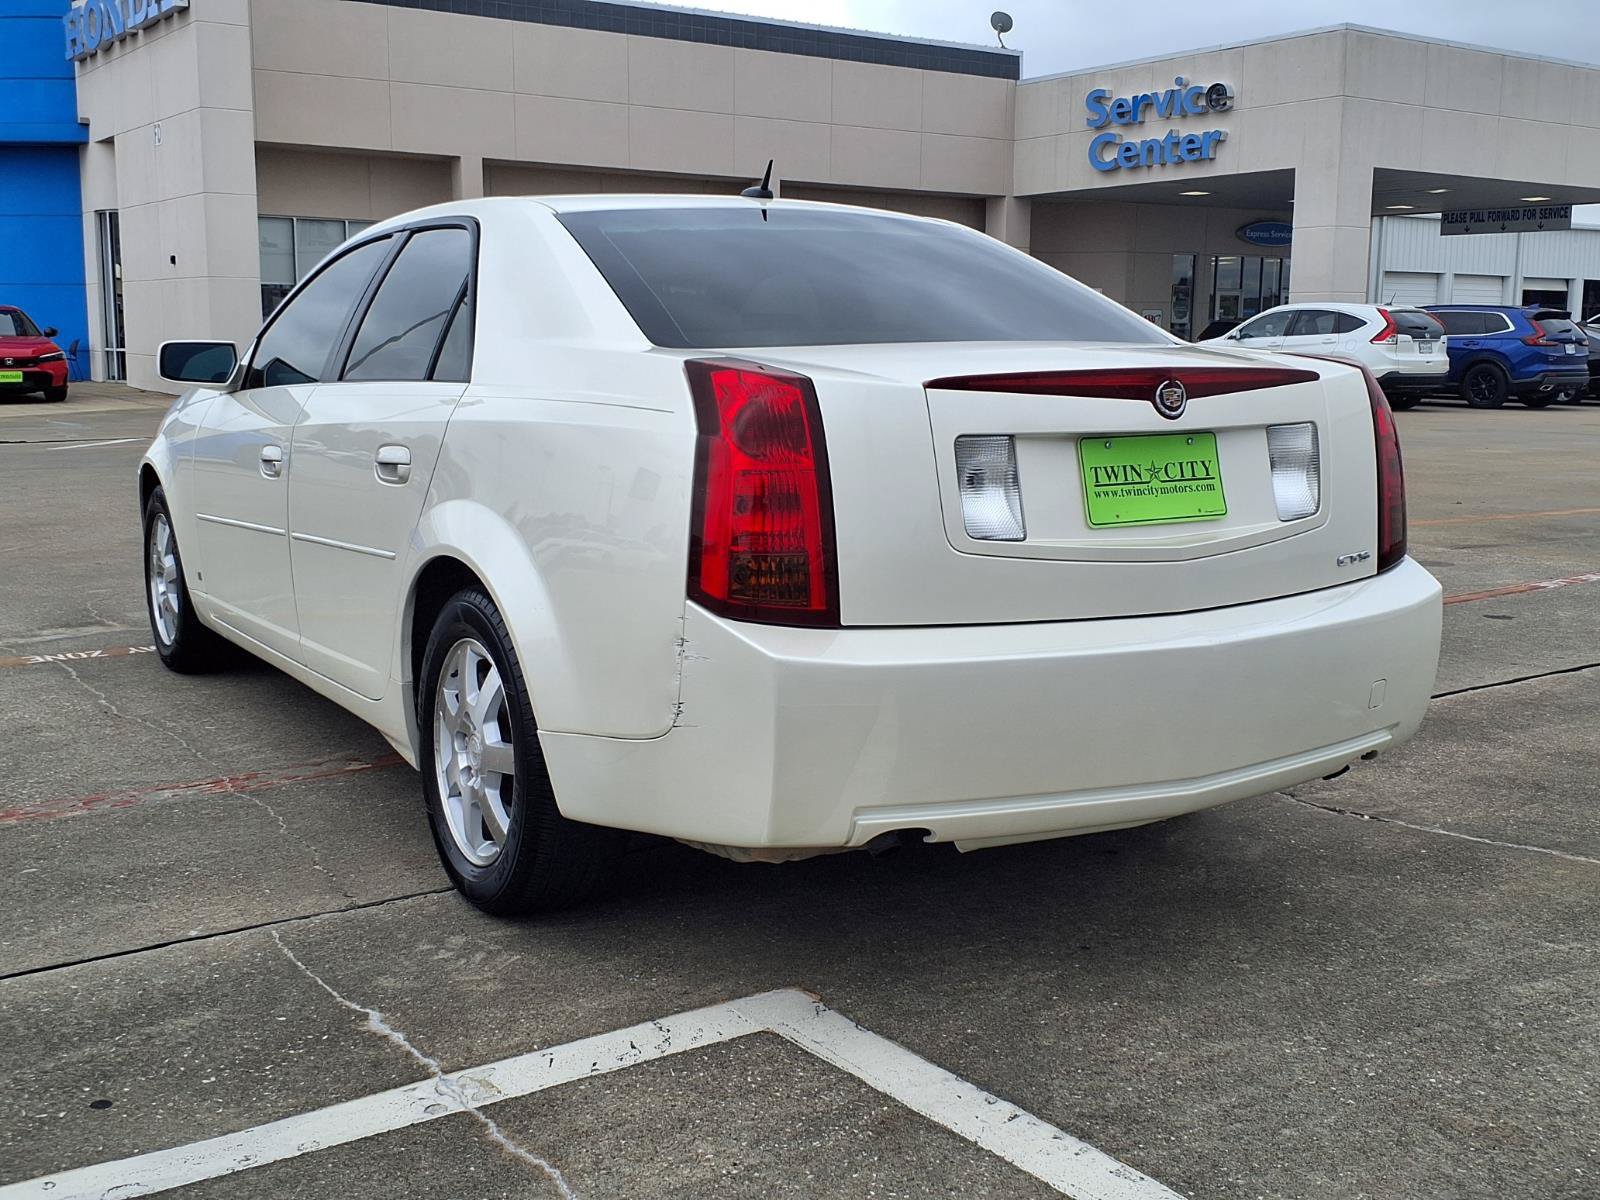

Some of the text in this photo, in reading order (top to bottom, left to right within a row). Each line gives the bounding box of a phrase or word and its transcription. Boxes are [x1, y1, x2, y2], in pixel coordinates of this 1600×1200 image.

[1085, 76, 1235, 129] Service
[1088, 129, 1228, 173] Center
[1442, 206, 1569, 224] PLEASE PULL FORWARD FOR SERVICE
[1246, 229, 1270, 239] Express
[1090, 459, 1213, 484] TWIN CITY
[1094, 482, 1216, 499] www.twincitymotors.com
